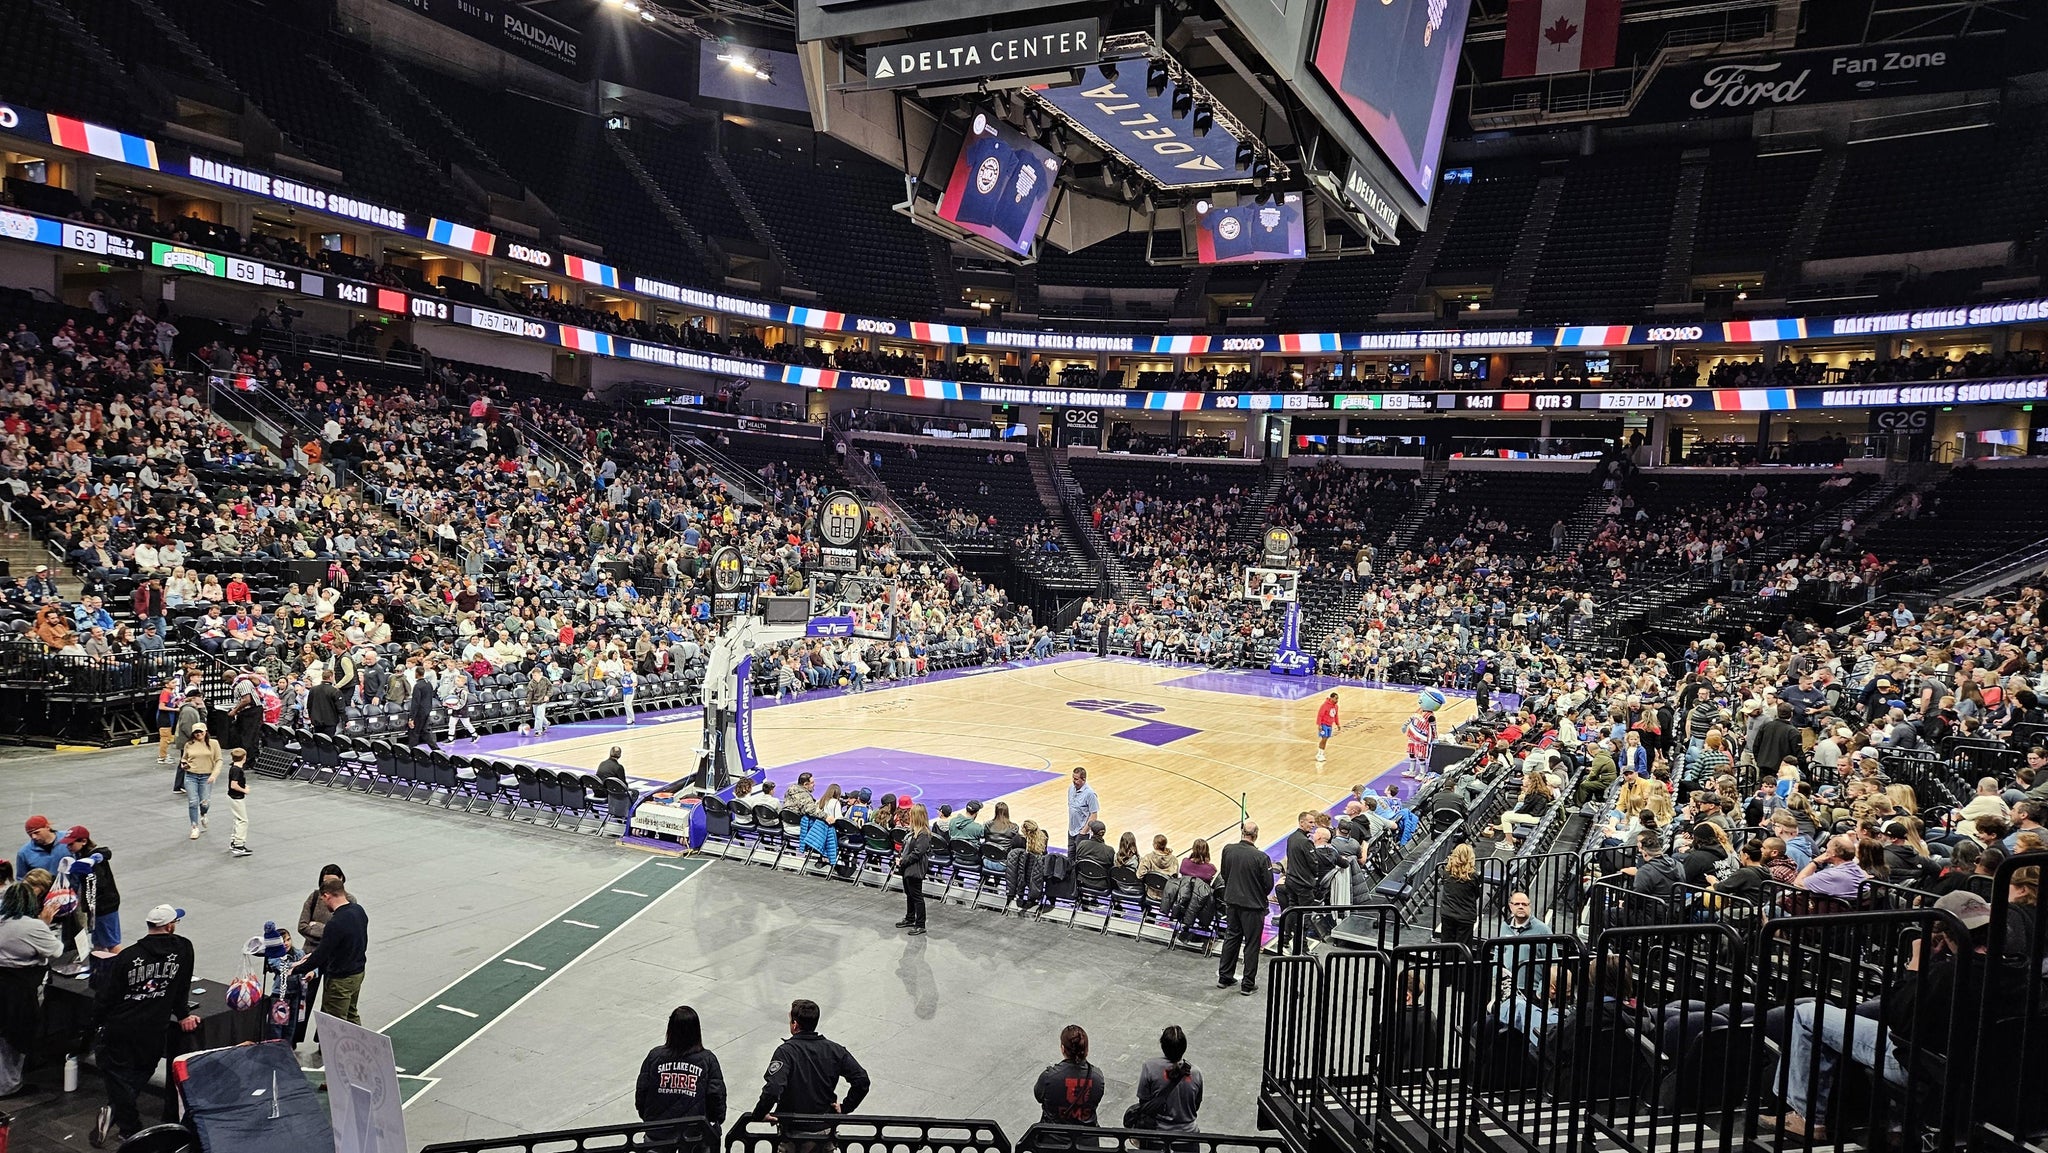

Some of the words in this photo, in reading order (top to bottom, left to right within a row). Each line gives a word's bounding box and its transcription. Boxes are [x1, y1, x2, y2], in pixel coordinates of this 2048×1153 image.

[901, 45, 981, 73] DELTA
[990, 31, 1088, 62] CENTER
[1831, 58, 1876, 75] Fan
[1882, 52, 1947, 70] Zone
[1689, 62, 1811, 109] Ford
[1080, 82, 1195, 155] DELTA
[189, 156, 270, 196] HALFTIME
[272, 179, 327, 210] SKILLS
[328, 194, 406, 231] SHOWCASE
[1355, 176, 1377, 210] DELTA
[1375, 198, 1398, 230] CENTER
[75, 230, 96, 249] 63
[236, 265, 256, 281] 59
[337, 282, 368, 305] 14:11
[635, 276, 681, 301] HALFTIME
[681, 287, 715, 309] SKILLS
[716, 295, 770, 319] SHOWCASE
[411, 297, 436, 319] QTR
[437, 302, 448, 320] 3
[478, 313, 500, 332] 7:57
[502, 317, 518, 336] PM
[1833, 313, 1910, 335] HALFTIME
[1910, 309, 1967, 330] SKILLS
[986, 331, 1036, 347] HALFTIME
[1037, 334, 1076, 349] SKILLS
[1075, 337, 1133, 351] SHOWCASE
[1361, 335, 1417, 349] HALFTIME
[1419, 333, 1461, 347] SKILLS
[1462, 331, 1533, 345] SHOWCASE
[629, 342, 676, 364] HALFTIME
[676, 351, 709, 370] SKILLS
[711, 357, 765, 379] SHOWCASE
[981, 387, 1031, 402] HALFTIME
[1032, 390, 1067, 405] SKILLS
[1068, 392, 1127, 406] SHOWCASE
[1289, 396, 1303, 408] 63
[1388, 396, 1403, 408] 59
[1466, 395, 1494, 408] 14:11
[1535, 395, 1560, 410] QTR
[1561, 395, 1572, 407] 3
[1608, 396, 1633, 408] 7:57
[1637, 396, 1656, 408] PM
[1822, 388, 1898, 406] HALFTIME
[1899, 384, 1956, 404] SKILLS
[1957, 380, 2048, 402] SHOWCASE
[747, 421, 767, 432] HEALTH
[1065, 409, 1098, 424] G2G
[1877, 411, 1928, 429] G2G
[743, 678, 751, 709] FIRST
[743, 711, 754, 760] AMERICA
[657, 1061, 673, 1074] SALT
[673, 1061, 690, 1072] LAKE
[689, 1062, 703, 1077] CITY
[659, 1072, 699, 1092] FIRE
[657, 1088, 698, 1098] DEPARTMENT
